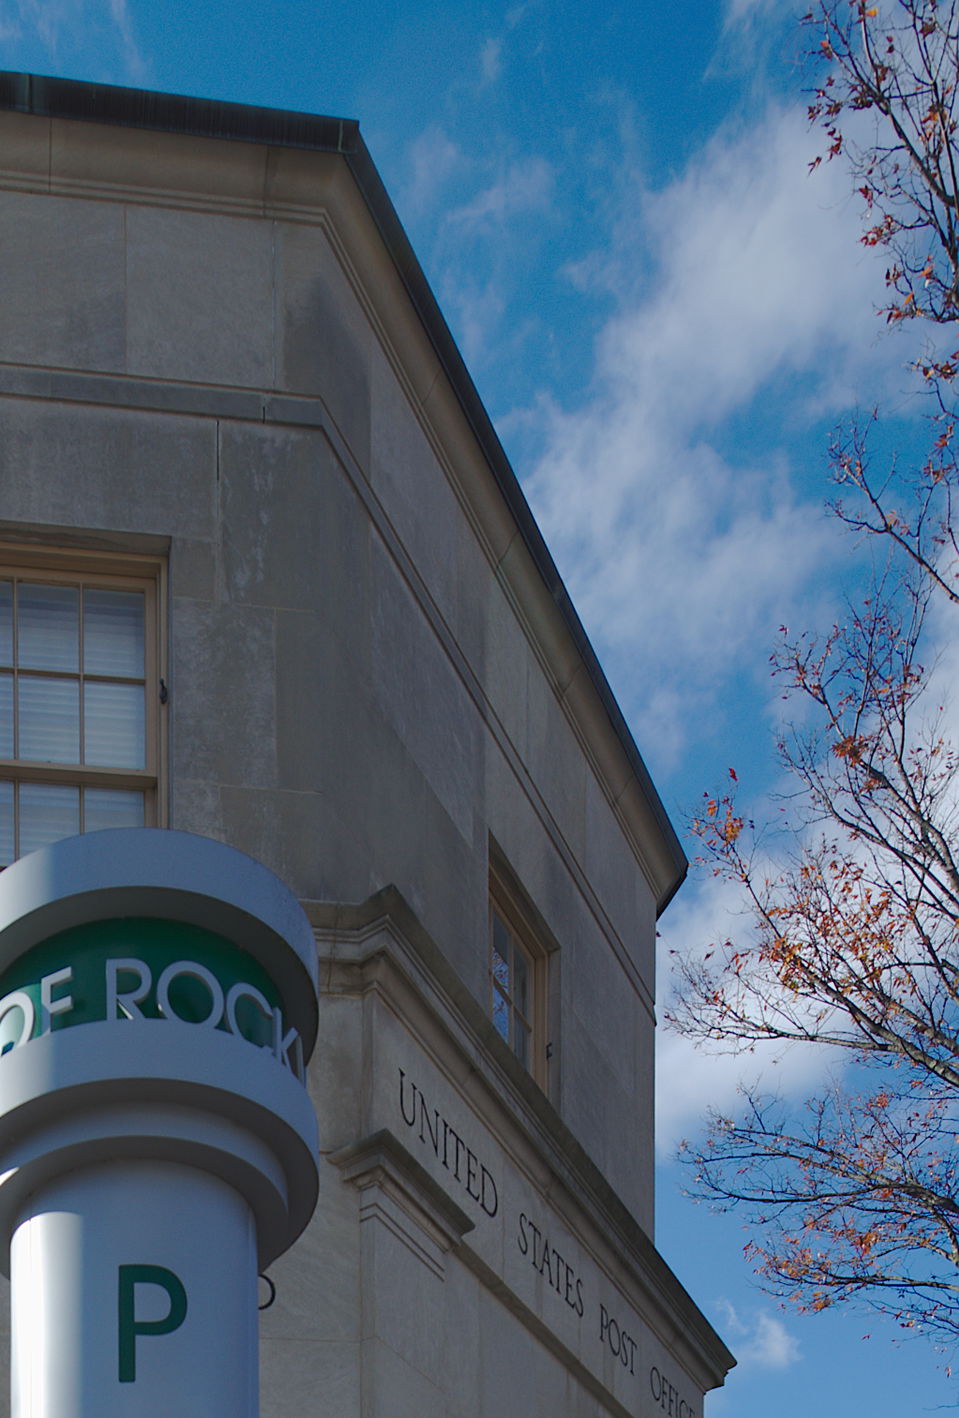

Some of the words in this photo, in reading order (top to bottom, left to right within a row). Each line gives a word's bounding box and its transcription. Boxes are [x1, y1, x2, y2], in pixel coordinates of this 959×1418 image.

[105, 957, 306, 1087] ROCK
[398, 1068, 499, 1218] UNITED
[517, 1212, 584, 1318] STATES
[599, 1303, 638, 1376] POST
